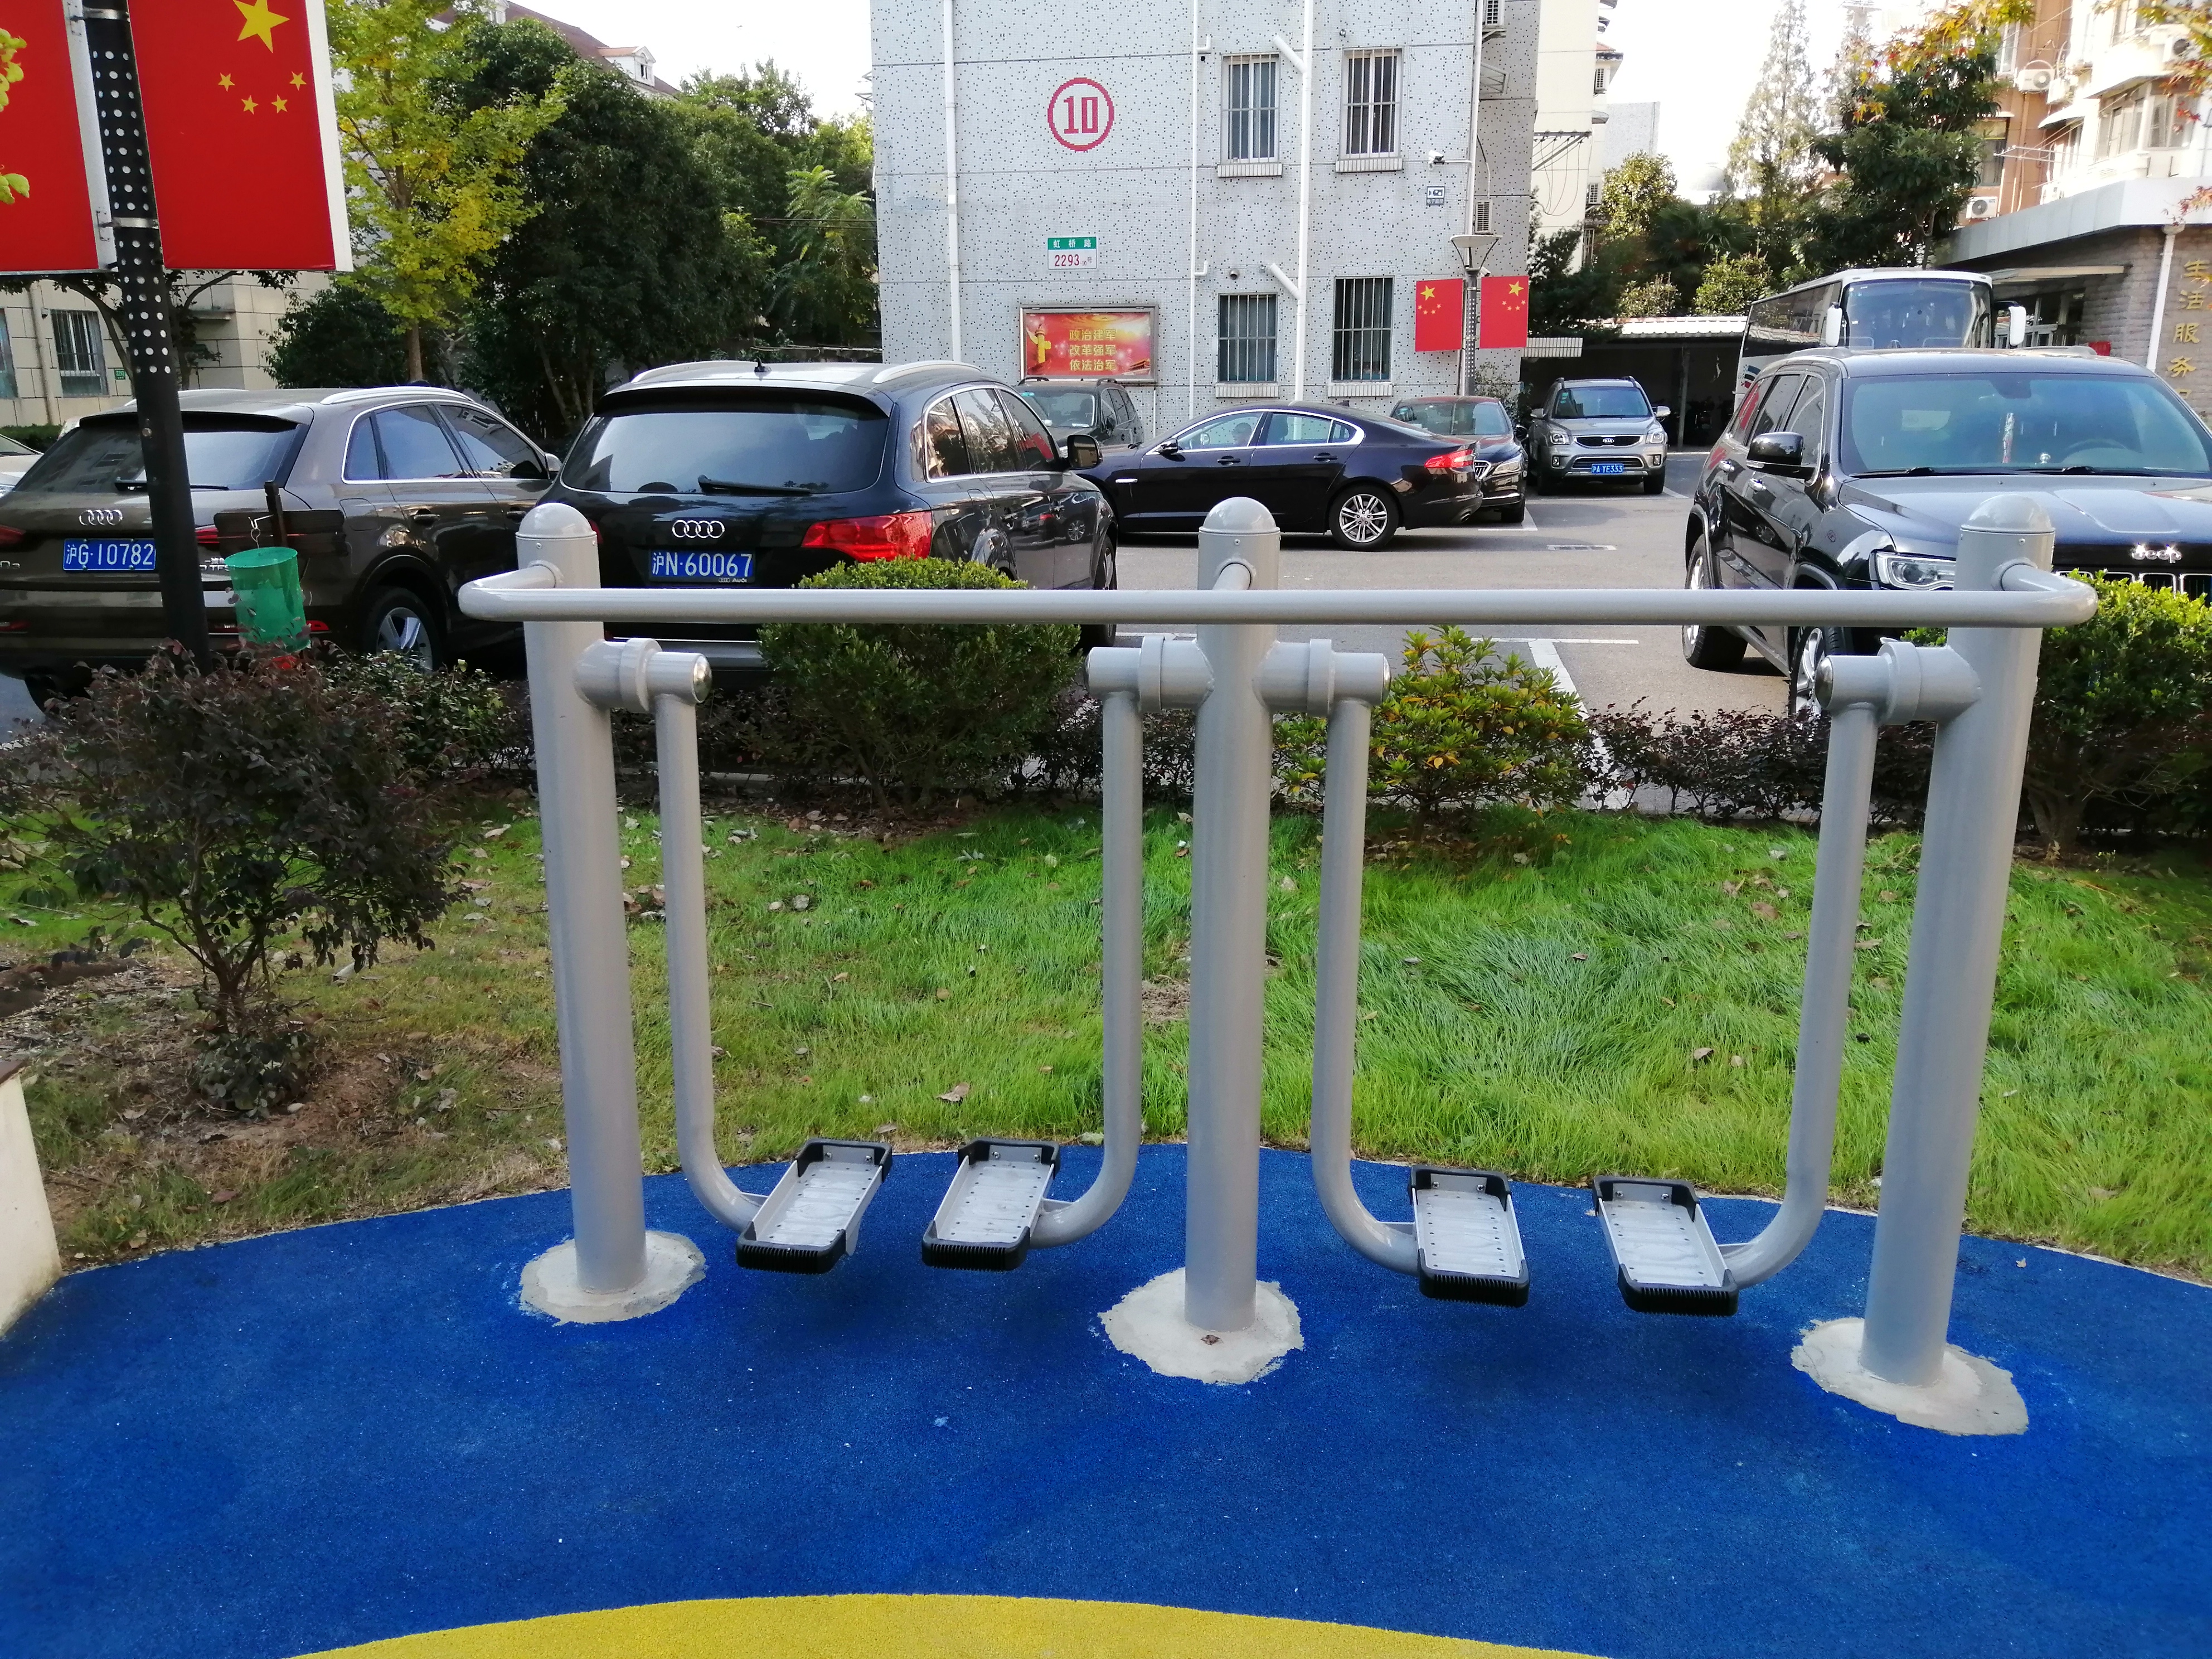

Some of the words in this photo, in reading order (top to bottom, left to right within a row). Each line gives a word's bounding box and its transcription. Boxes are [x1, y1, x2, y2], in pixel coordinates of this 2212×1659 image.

[1064, 96, 1098, 133] 10
[1053, 239, 1092, 248] 虹桥路
[1069, 329, 1116, 341] 政治建军
[1069, 345, 1115, 356] 改革强军
[1070, 360, 1115, 371] 依法治军
